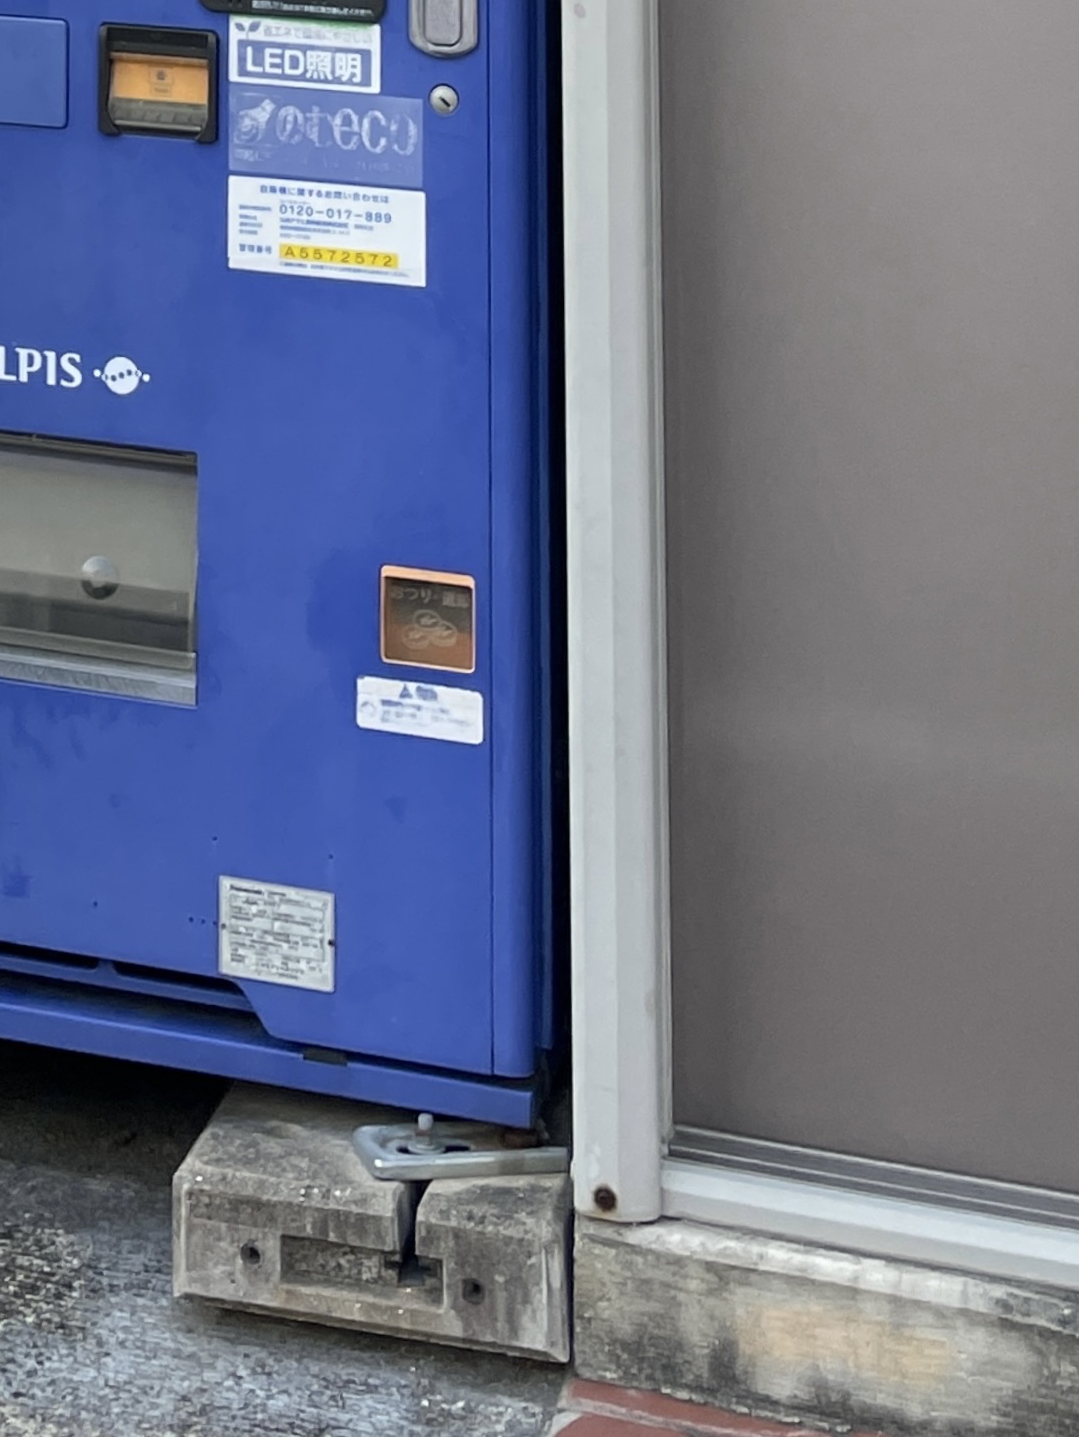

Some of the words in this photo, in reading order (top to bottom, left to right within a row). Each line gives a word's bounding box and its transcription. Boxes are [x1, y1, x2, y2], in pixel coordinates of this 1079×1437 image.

[245, 45, 363, 83] LED照明
[259, 184, 391, 204] 自販機に関するお問い合わせは
[278, 203, 393, 225] 0120-017-889
[283, 245, 394, 268] A5572572
